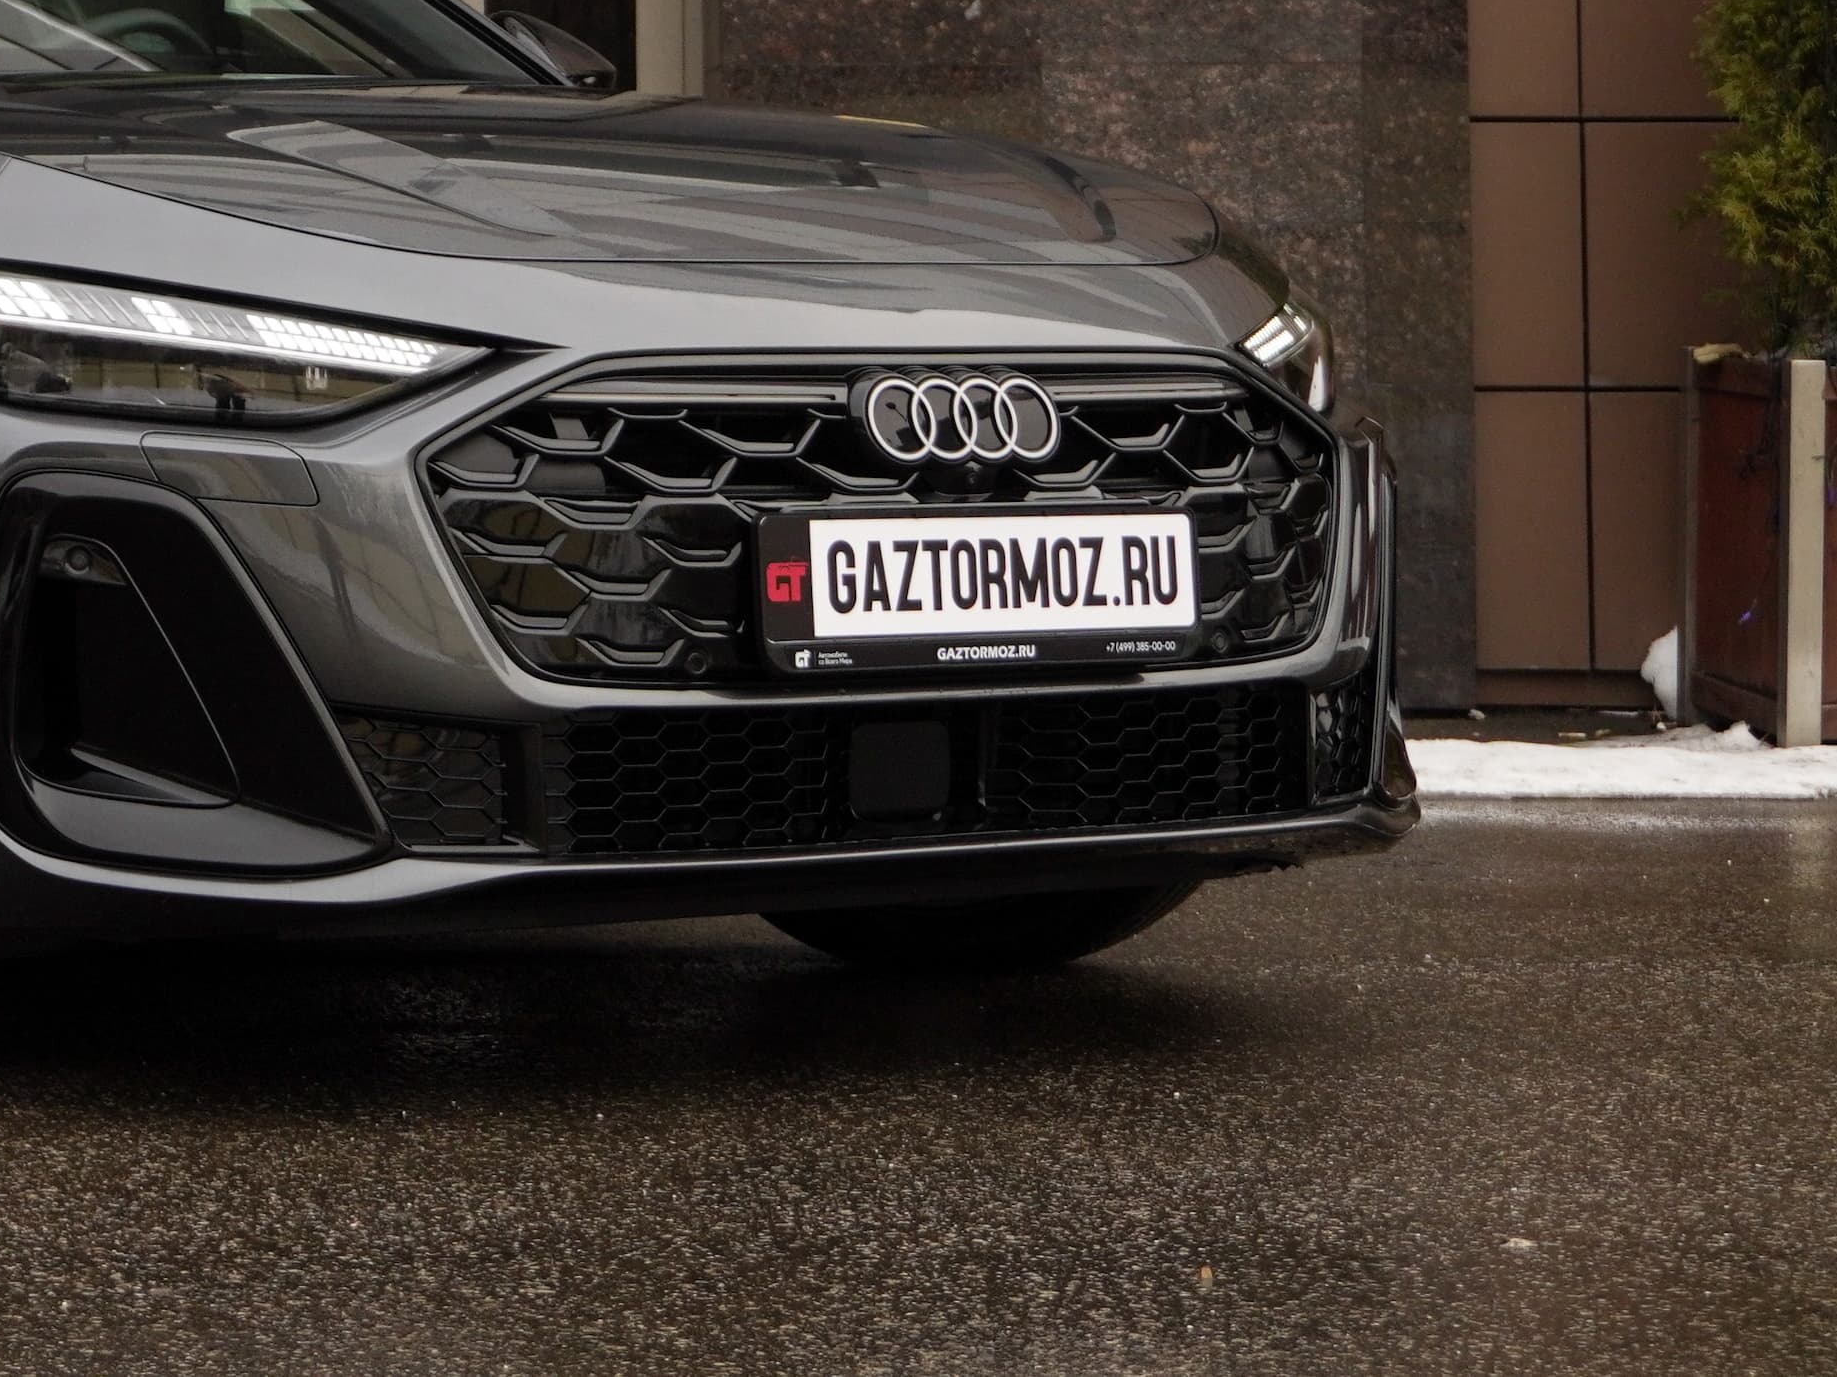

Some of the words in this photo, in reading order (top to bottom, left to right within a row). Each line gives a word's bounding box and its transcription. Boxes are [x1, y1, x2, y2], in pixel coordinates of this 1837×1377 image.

[766, 561, 808, 602] GT
[826, 535, 1179, 614] GAZTORMOZ.RU
[937, 644, 1036, 660] GAZTORMOZ.RU
[1106, 642, 1115, 652] +7
[1115, 641, 1135, 653] (499)
